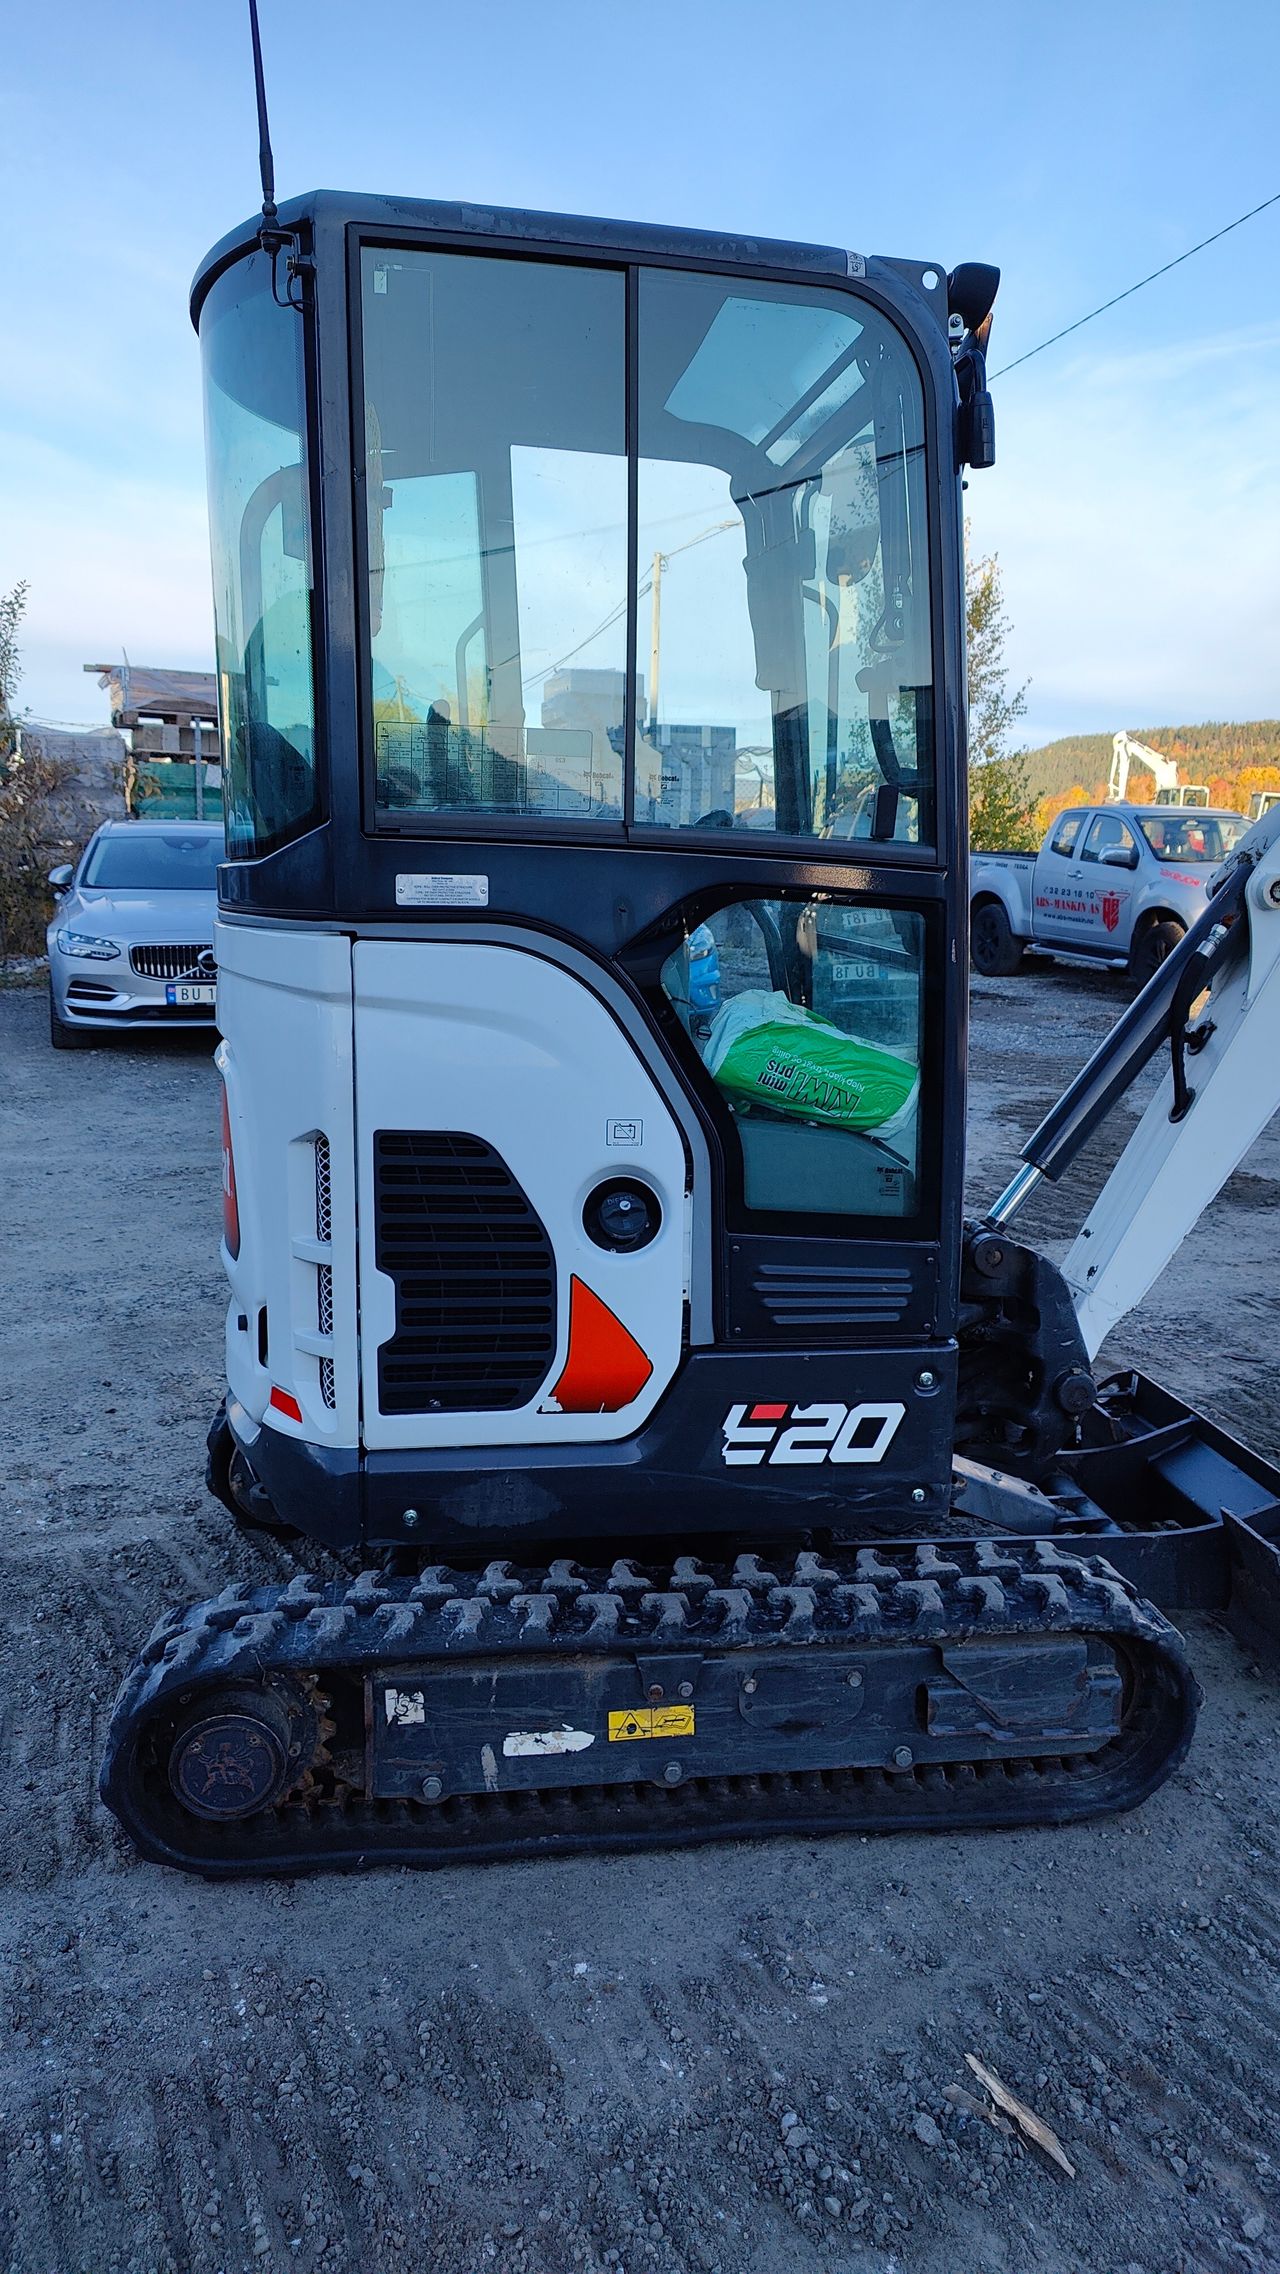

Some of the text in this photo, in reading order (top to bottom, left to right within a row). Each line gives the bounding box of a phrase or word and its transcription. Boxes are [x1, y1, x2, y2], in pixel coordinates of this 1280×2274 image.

[1049, 887, 1058, 895] 32
[1061, 888, 1071, 896] 23
[1086, 891, 1095, 899] 10
[181, 987, 201, 1001] BU
[765, 1059, 796, 1081] pris
[755, 1072, 788, 1093] mini
[786, 1071, 861, 1120] KIWI
[721, 1402, 907, 1466] E20
